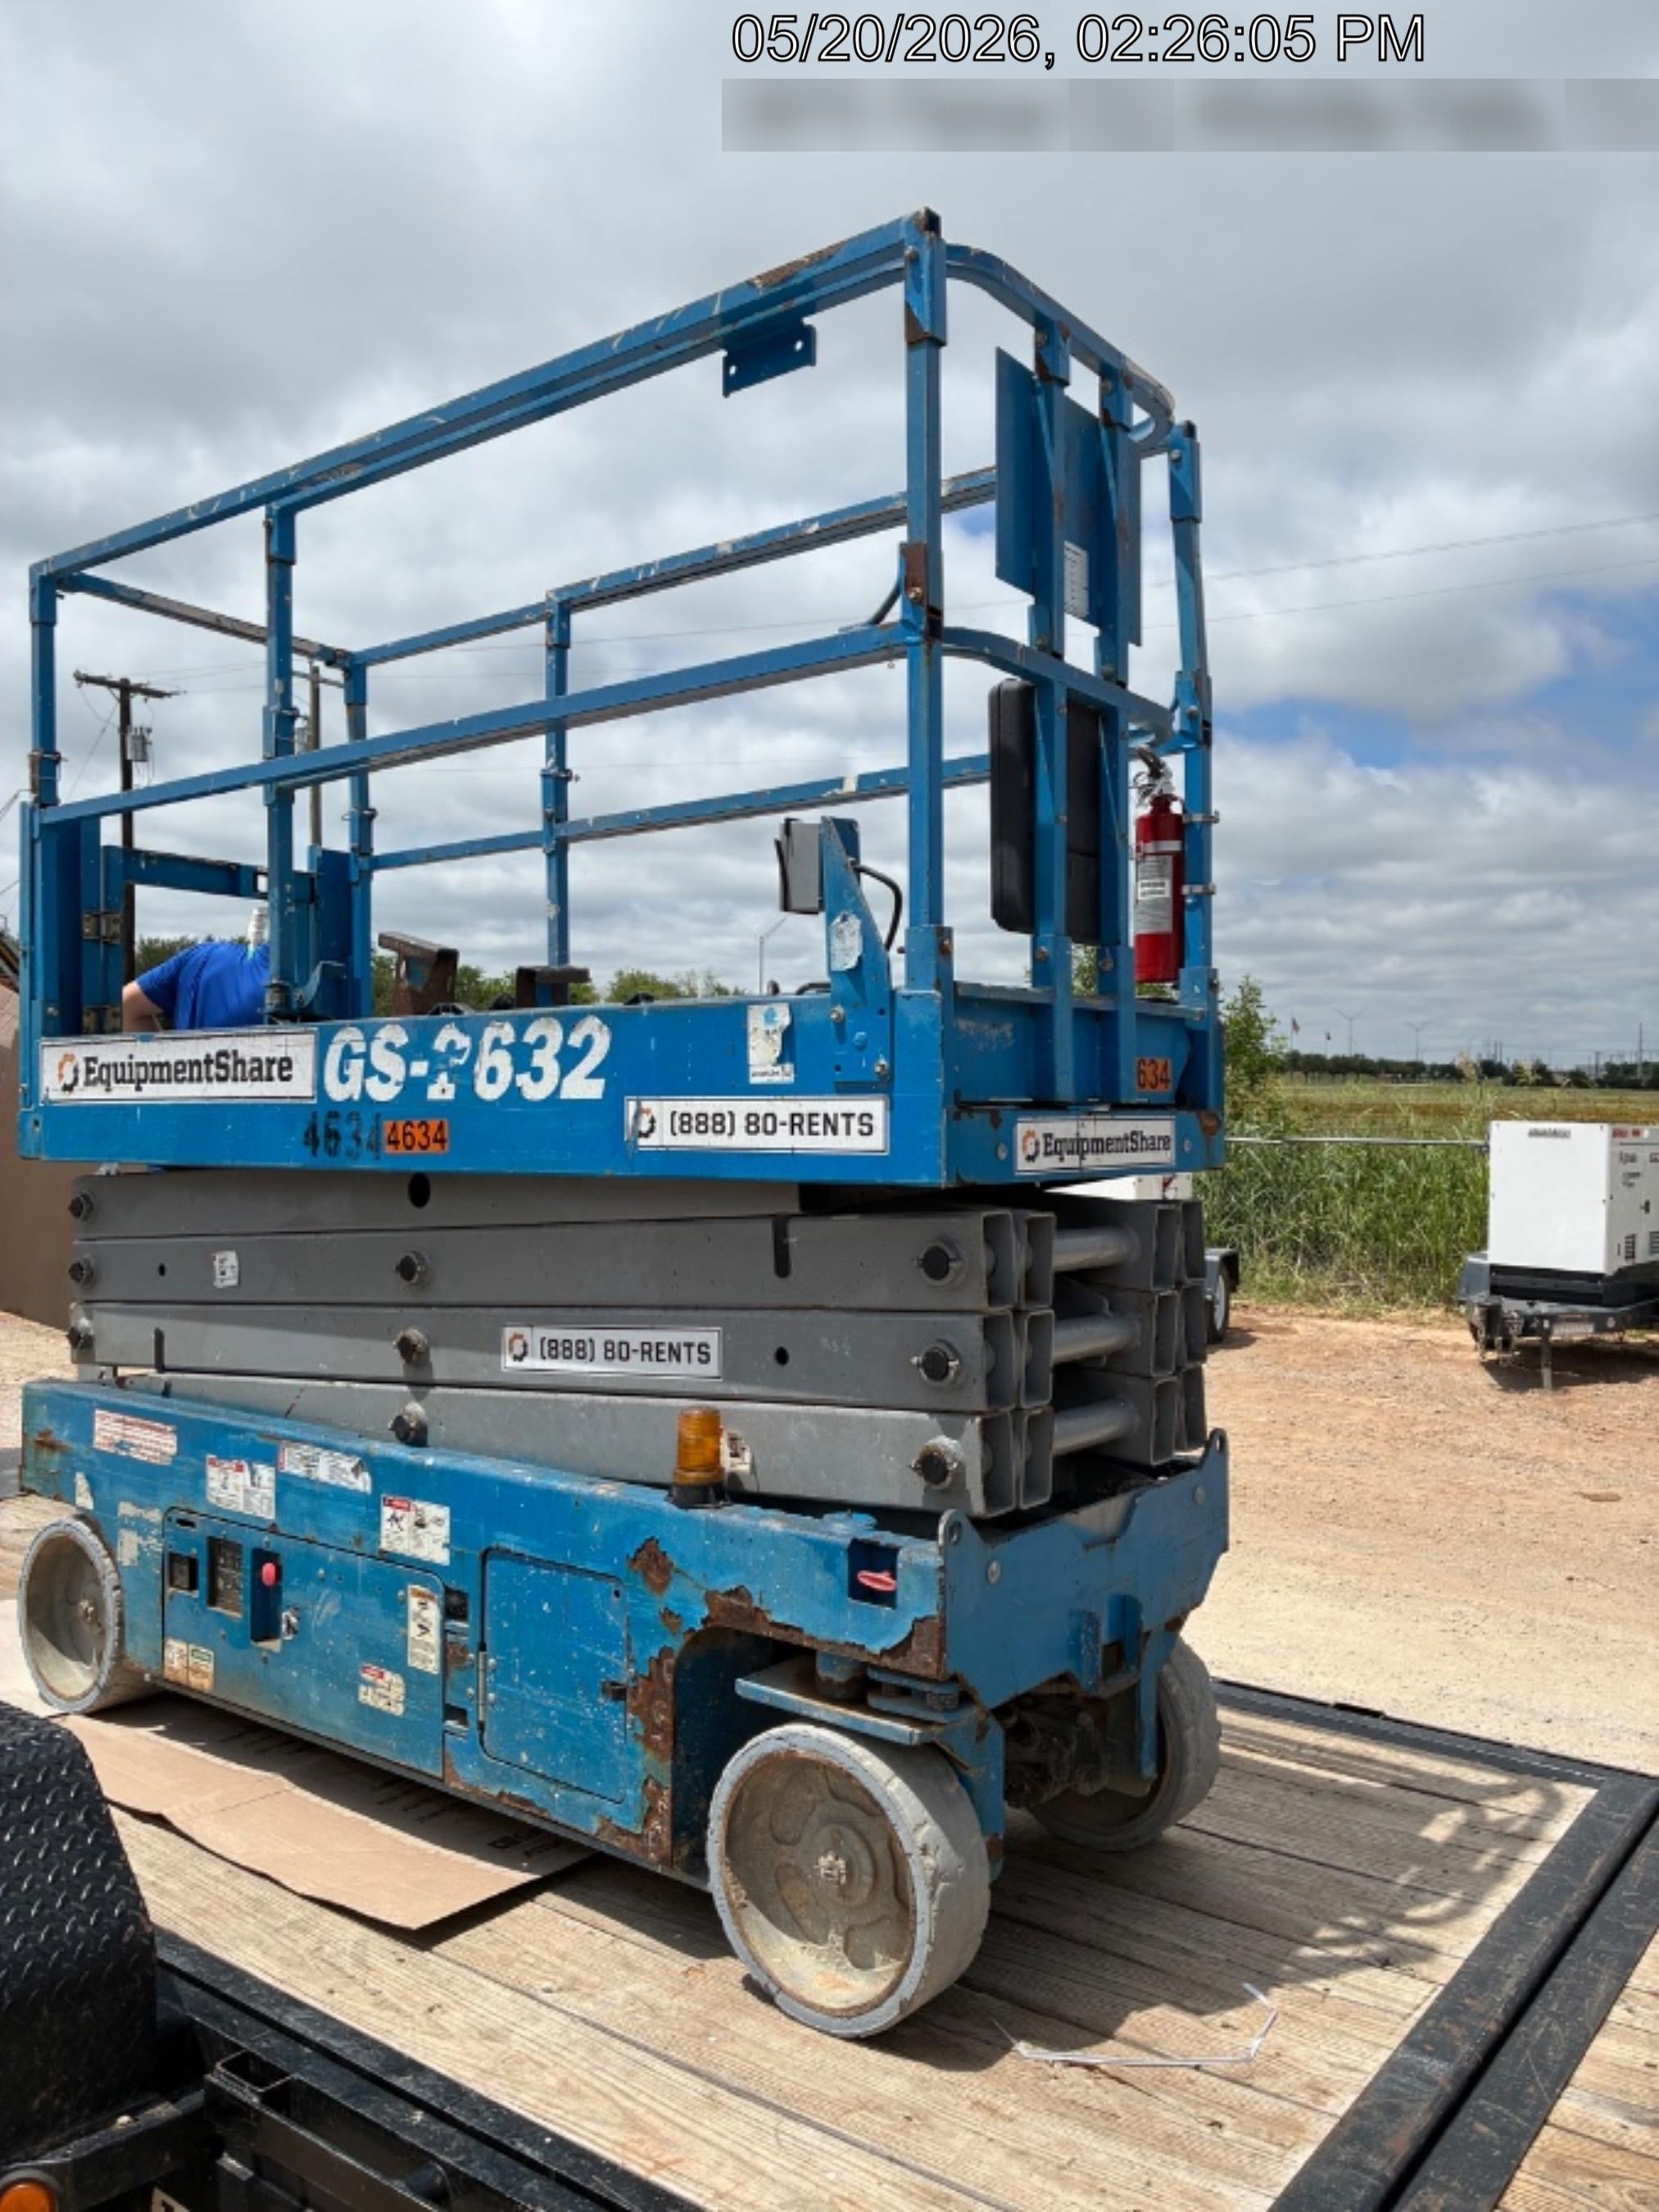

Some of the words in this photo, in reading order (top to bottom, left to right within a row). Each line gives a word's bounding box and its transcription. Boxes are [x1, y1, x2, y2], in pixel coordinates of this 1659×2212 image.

[83, 1049, 293, 1092] EquipmentShare
[323, 1016, 612, 1102] GS-2632
[304, 1110, 382, 1160] 4634
[387, 1120, 448, 1150] 4634
[669, 1110, 736, 1137] (888)
[744, 1112, 874, 1137] 80-RENTS
[1042, 1130, 1172, 1162] EquipmentShare
[539, 1336, 596, 1362] (888)
[603, 1339, 712, 1365] 80-RENTS
